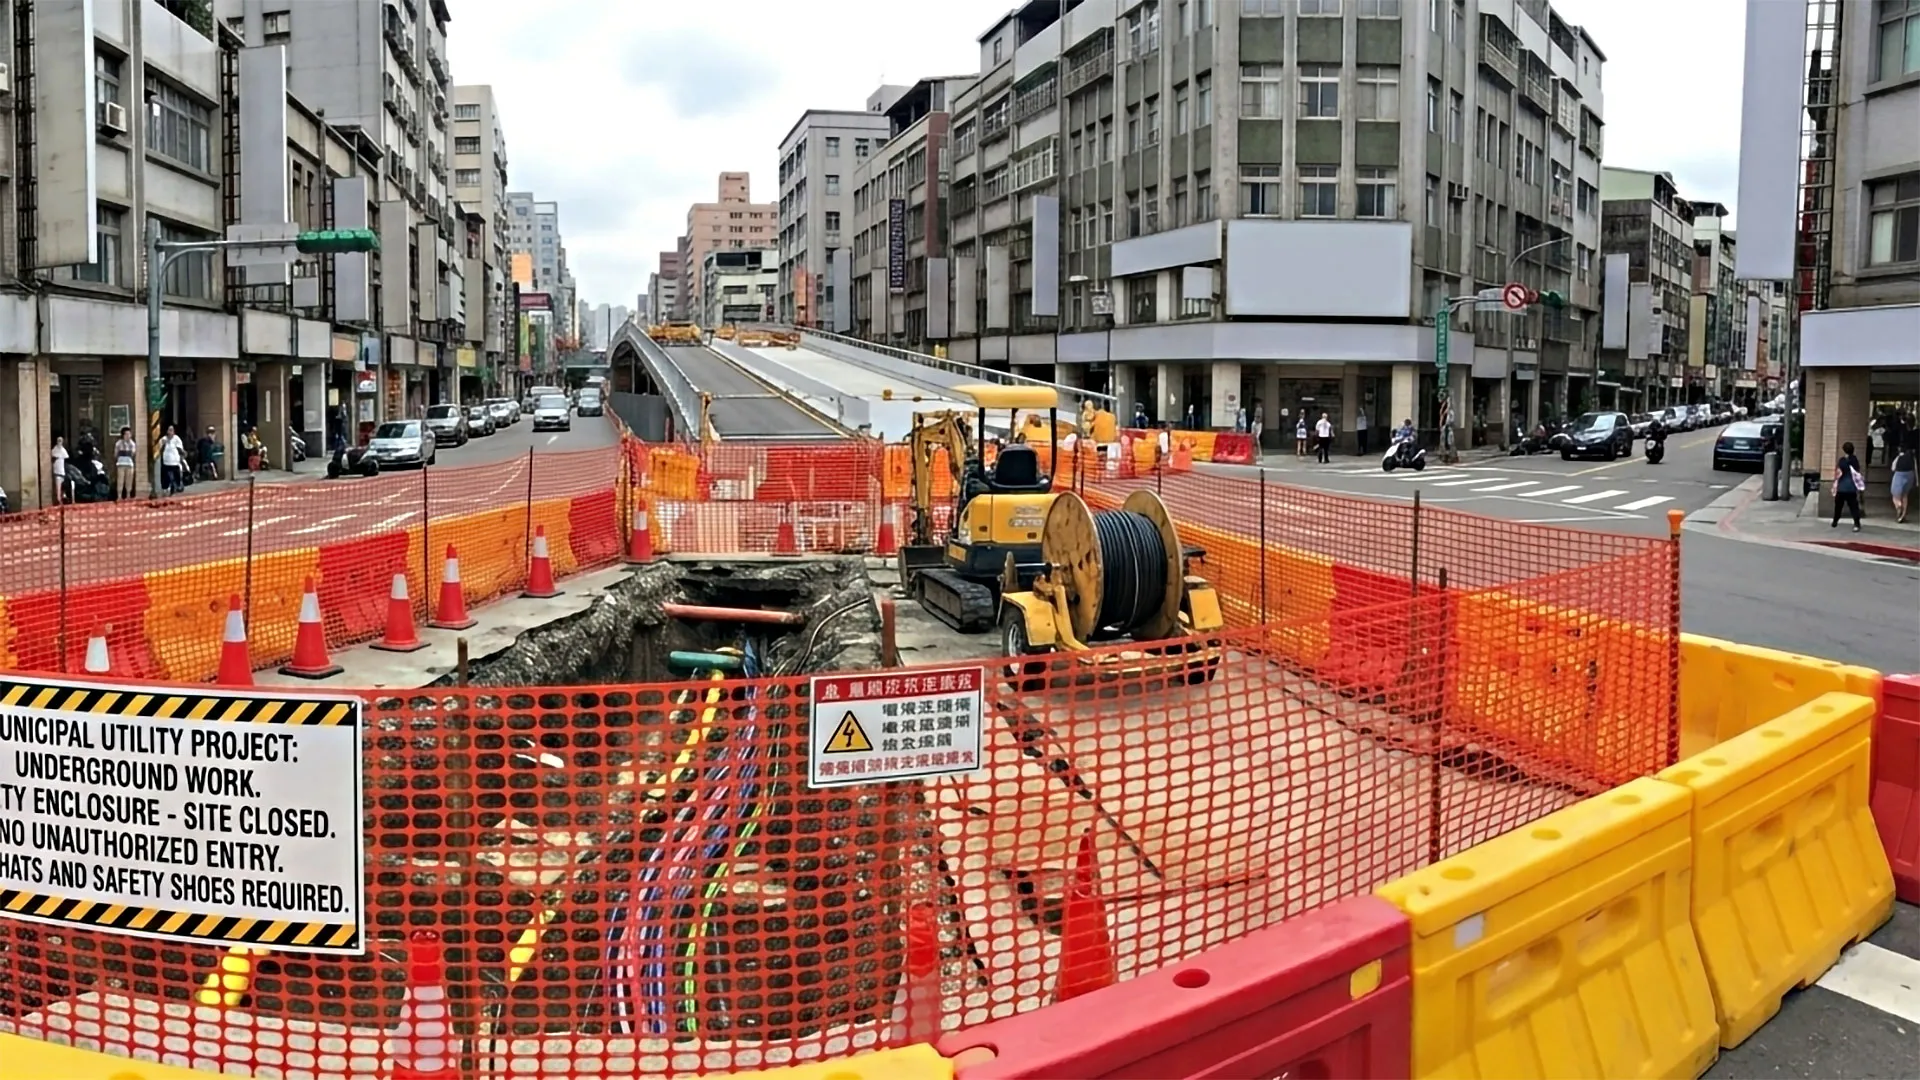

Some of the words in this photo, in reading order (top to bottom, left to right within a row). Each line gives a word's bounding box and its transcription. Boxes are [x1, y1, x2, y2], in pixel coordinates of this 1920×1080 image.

[102, 723, 183, 756] UTILITY
[192, 730, 298, 763] PROJECT:
[16, 750, 177, 792] UNDERGROUND
[185, 766, 261, 798] WORK.
[34, 787, 159, 826] ENCLOSURE
[184, 802, 232, 832] SITE
[240, 806, 336, 839] CLOSED.
[0, 817, 25, 847] NO
[33, 822, 198, 866] UNAUTHORIZED
[207, 841, 284, 873] ENTRY.
[0, 852, 43, 884] HATS
[49, 860, 87, 889] AND
[93, 865, 164, 898] SAFETY
[171, 873, 235, 906] SHOES
[243, 879, 349, 913] REQUIRED.
